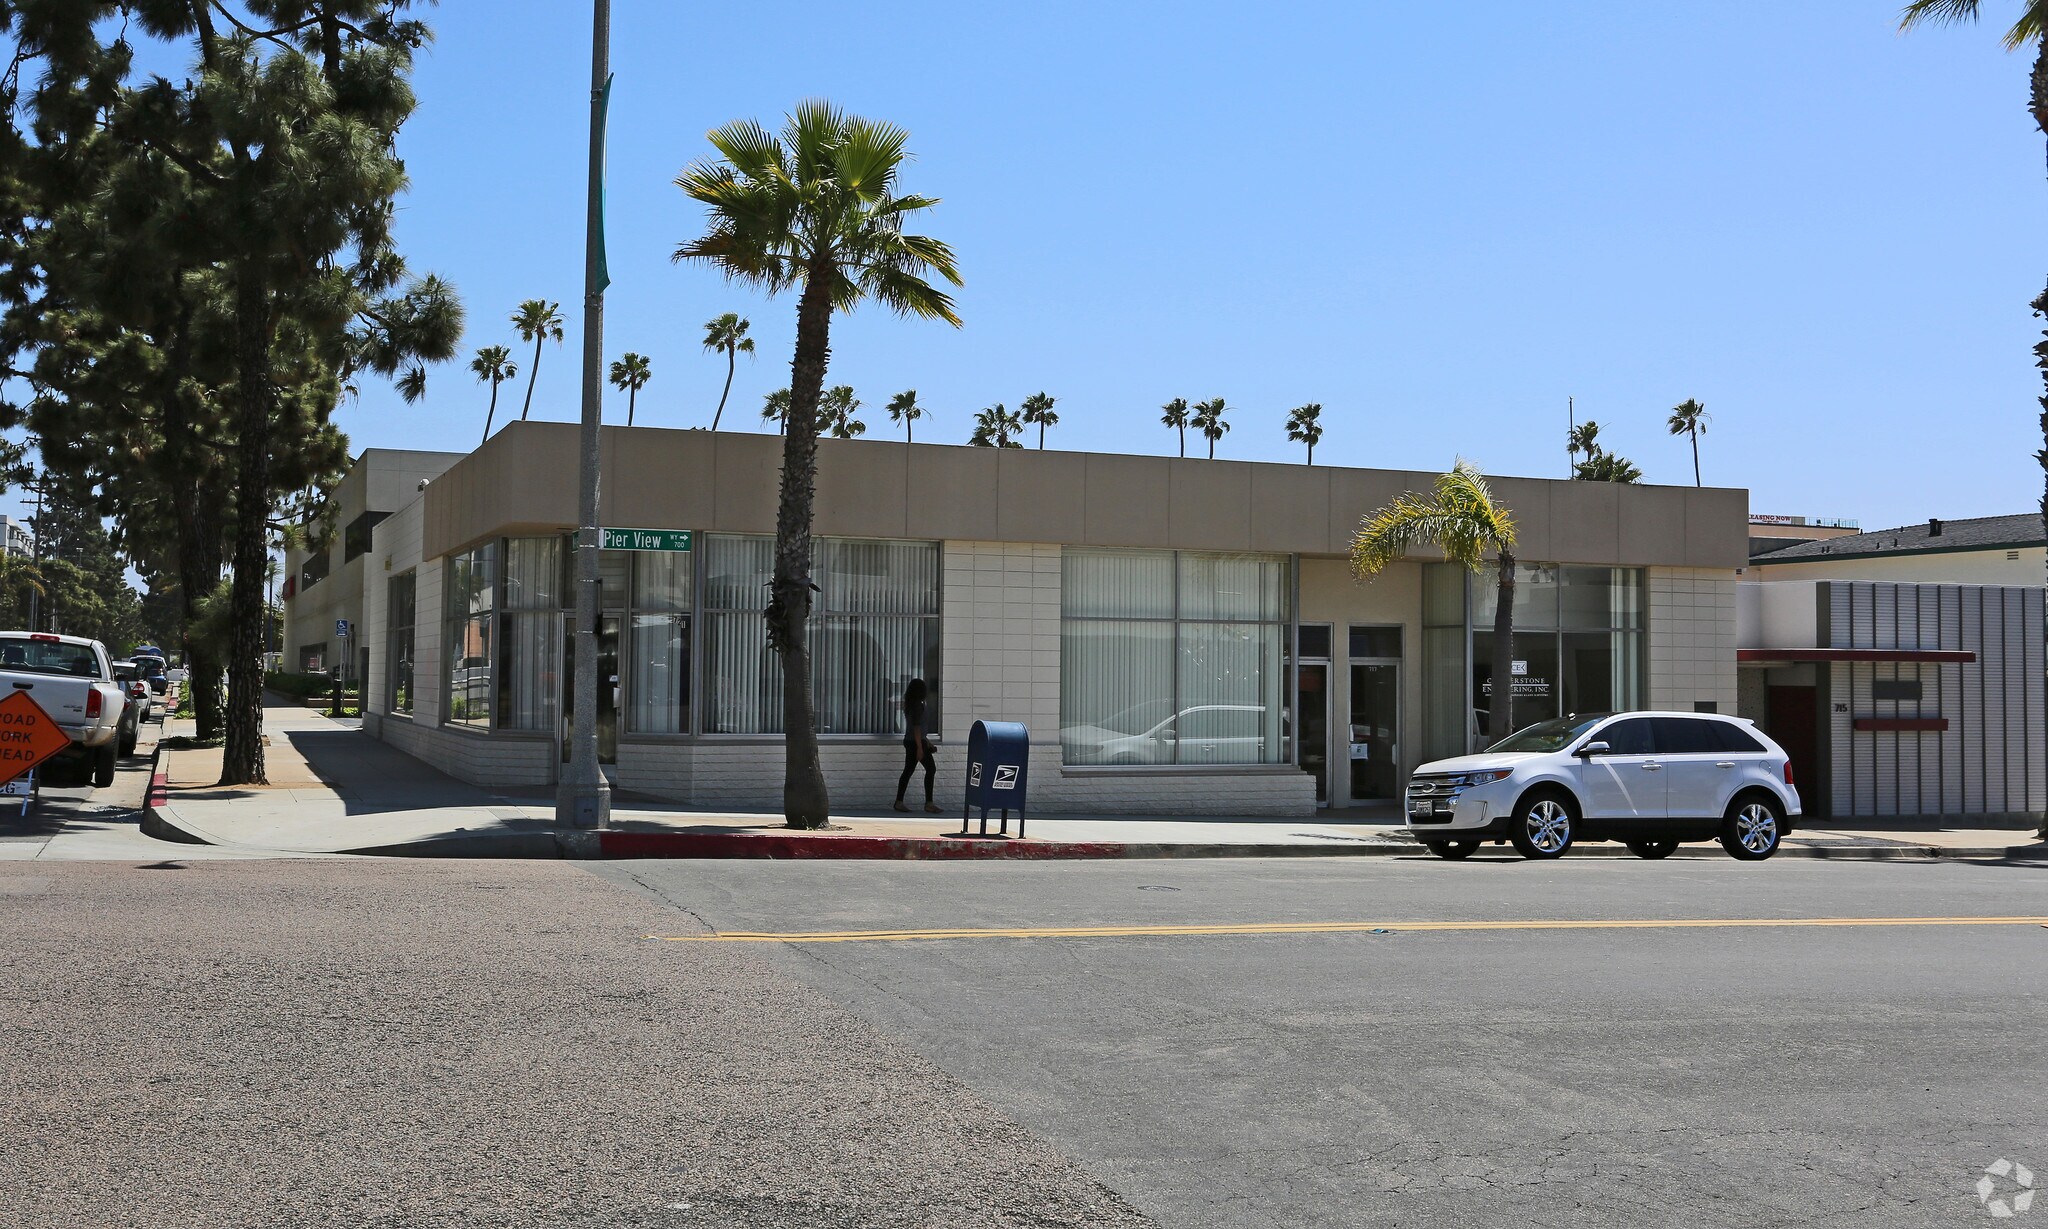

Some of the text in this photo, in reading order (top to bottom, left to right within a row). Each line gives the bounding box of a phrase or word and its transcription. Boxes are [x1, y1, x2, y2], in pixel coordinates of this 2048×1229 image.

[604, 531, 628, 547] Pier
[633, 532, 661, 548] View
[1835, 703, 1848, 712] 715
[0, 713, 36, 726] OAD
[0, 731, 33, 743] ORK
